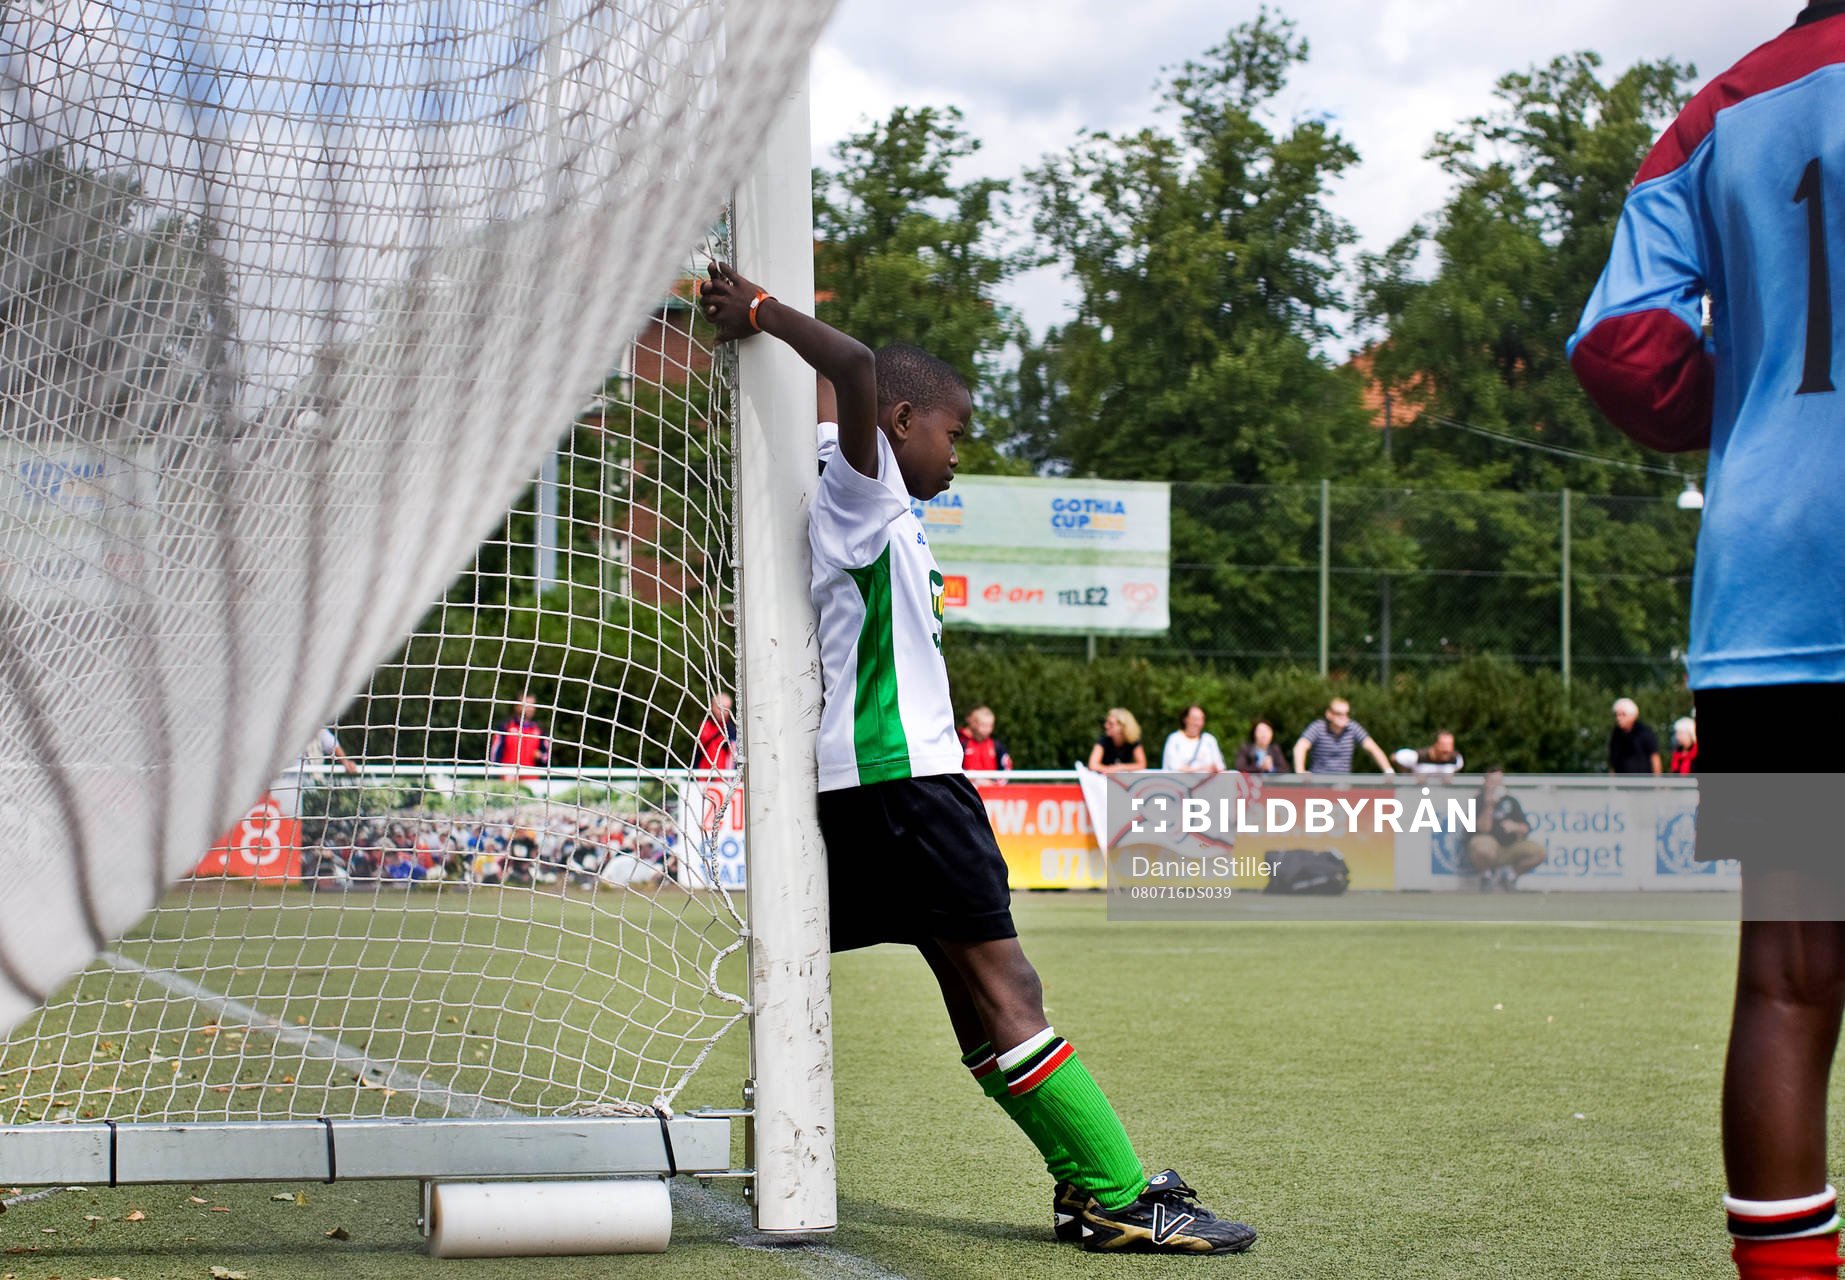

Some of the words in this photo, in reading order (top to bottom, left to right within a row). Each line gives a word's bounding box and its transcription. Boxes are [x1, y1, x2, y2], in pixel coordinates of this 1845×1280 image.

[1051, 498, 1126, 514] GOTHIA
[1051, 514, 1091, 529] CUP
[1524, 802, 1626, 833] ostads
